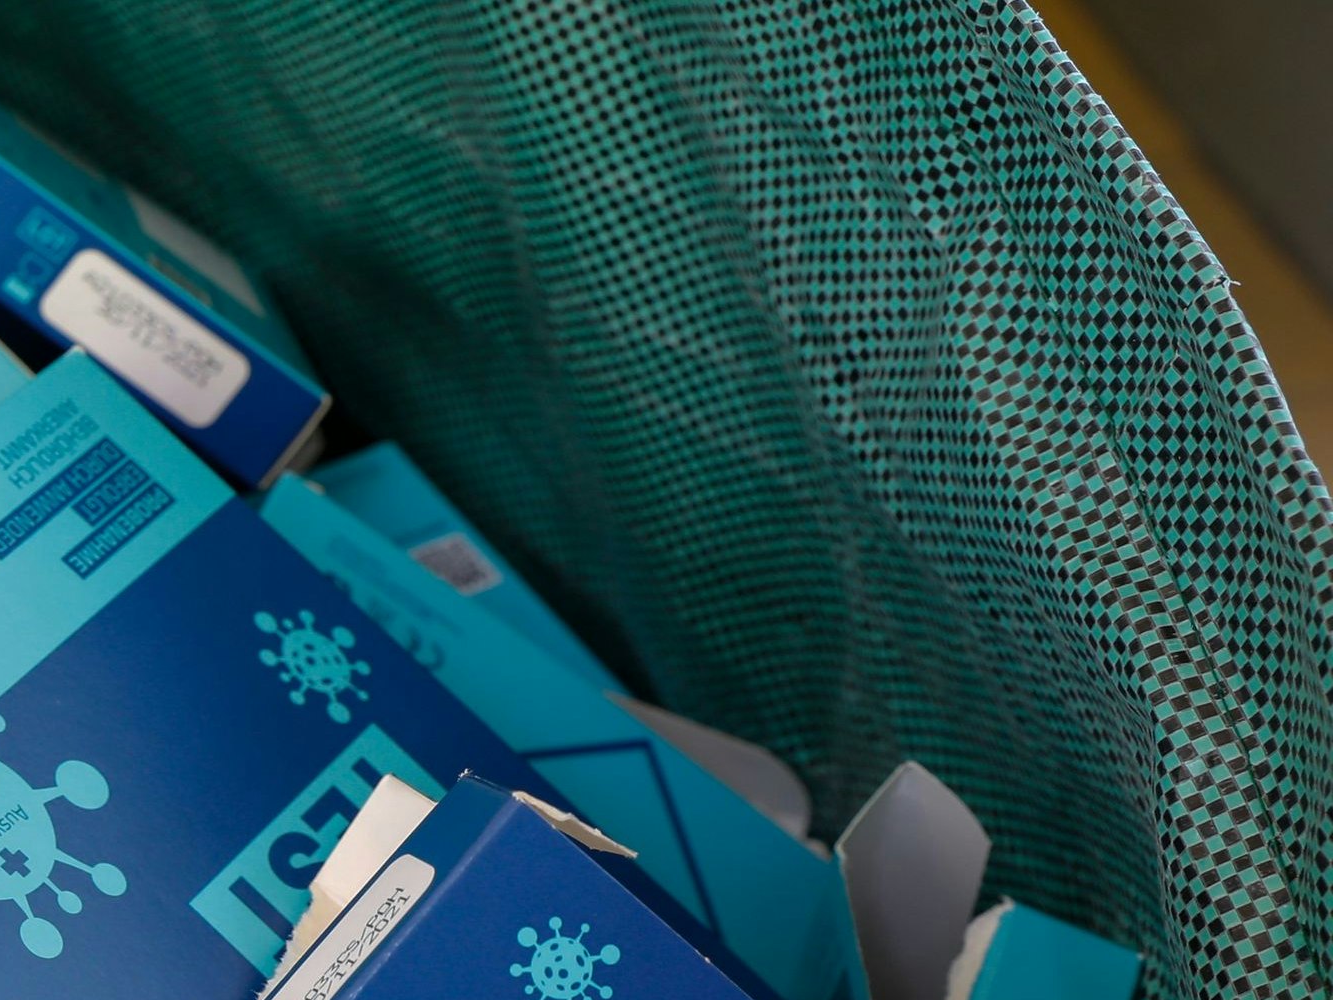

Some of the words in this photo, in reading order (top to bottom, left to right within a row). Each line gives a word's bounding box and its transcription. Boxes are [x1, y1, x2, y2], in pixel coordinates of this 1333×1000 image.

[8, 413, 100, 490] BEHÖRDLICH
[69, 441, 120, 486] DURCH
[81, 463, 146, 523] ERFOLGT
[69, 486, 171, 574] PROBENAHME
